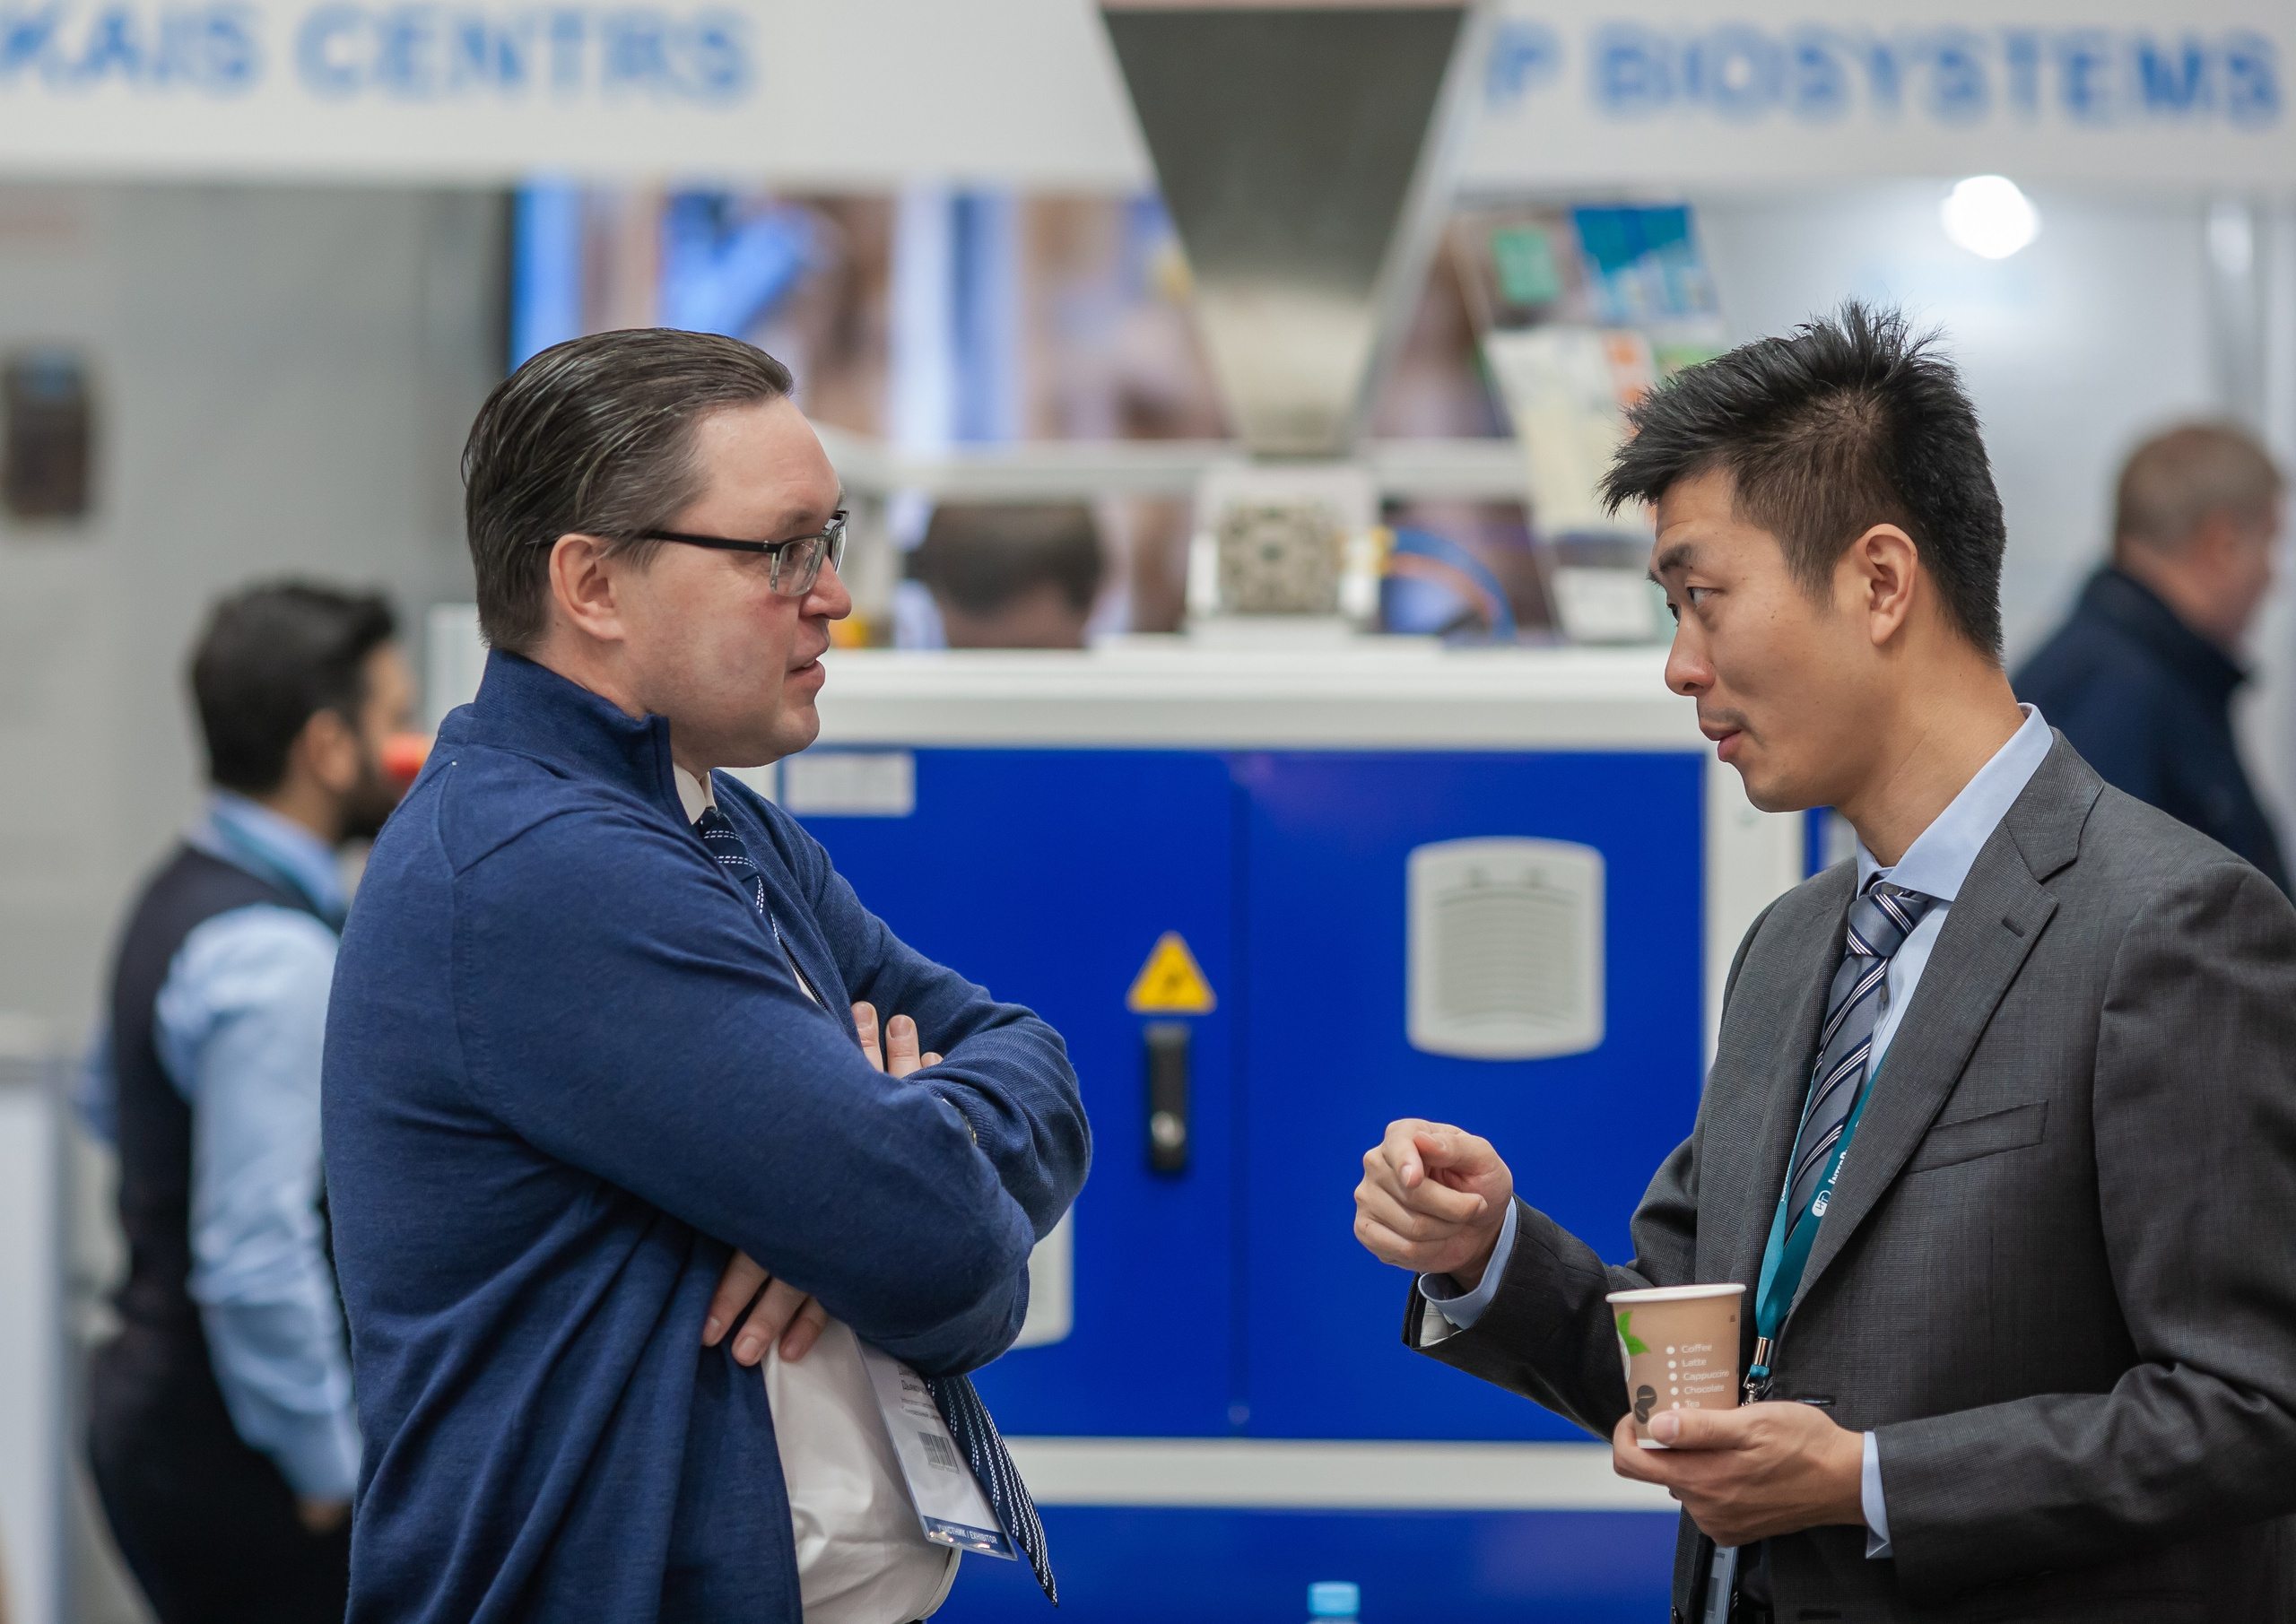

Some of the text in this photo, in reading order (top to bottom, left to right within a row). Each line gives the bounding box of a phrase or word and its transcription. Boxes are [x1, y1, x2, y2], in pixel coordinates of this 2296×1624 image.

[296, 7, 756, 104] CENTRS
[1589, 25, 2280, 129] BIOSYSTEMS
[1681, 1344, 1713, 1354] Coffee
[1681, 1359, 1707, 1368] Latte
[1683, 1369, 1730, 1382] Cappuccino
[1684, 1385, 1725, 1395] Chocolate
[1685, 1400, 1700, 1408] Tea
[969, 1530, 998, 1545] EXHIBITOR
